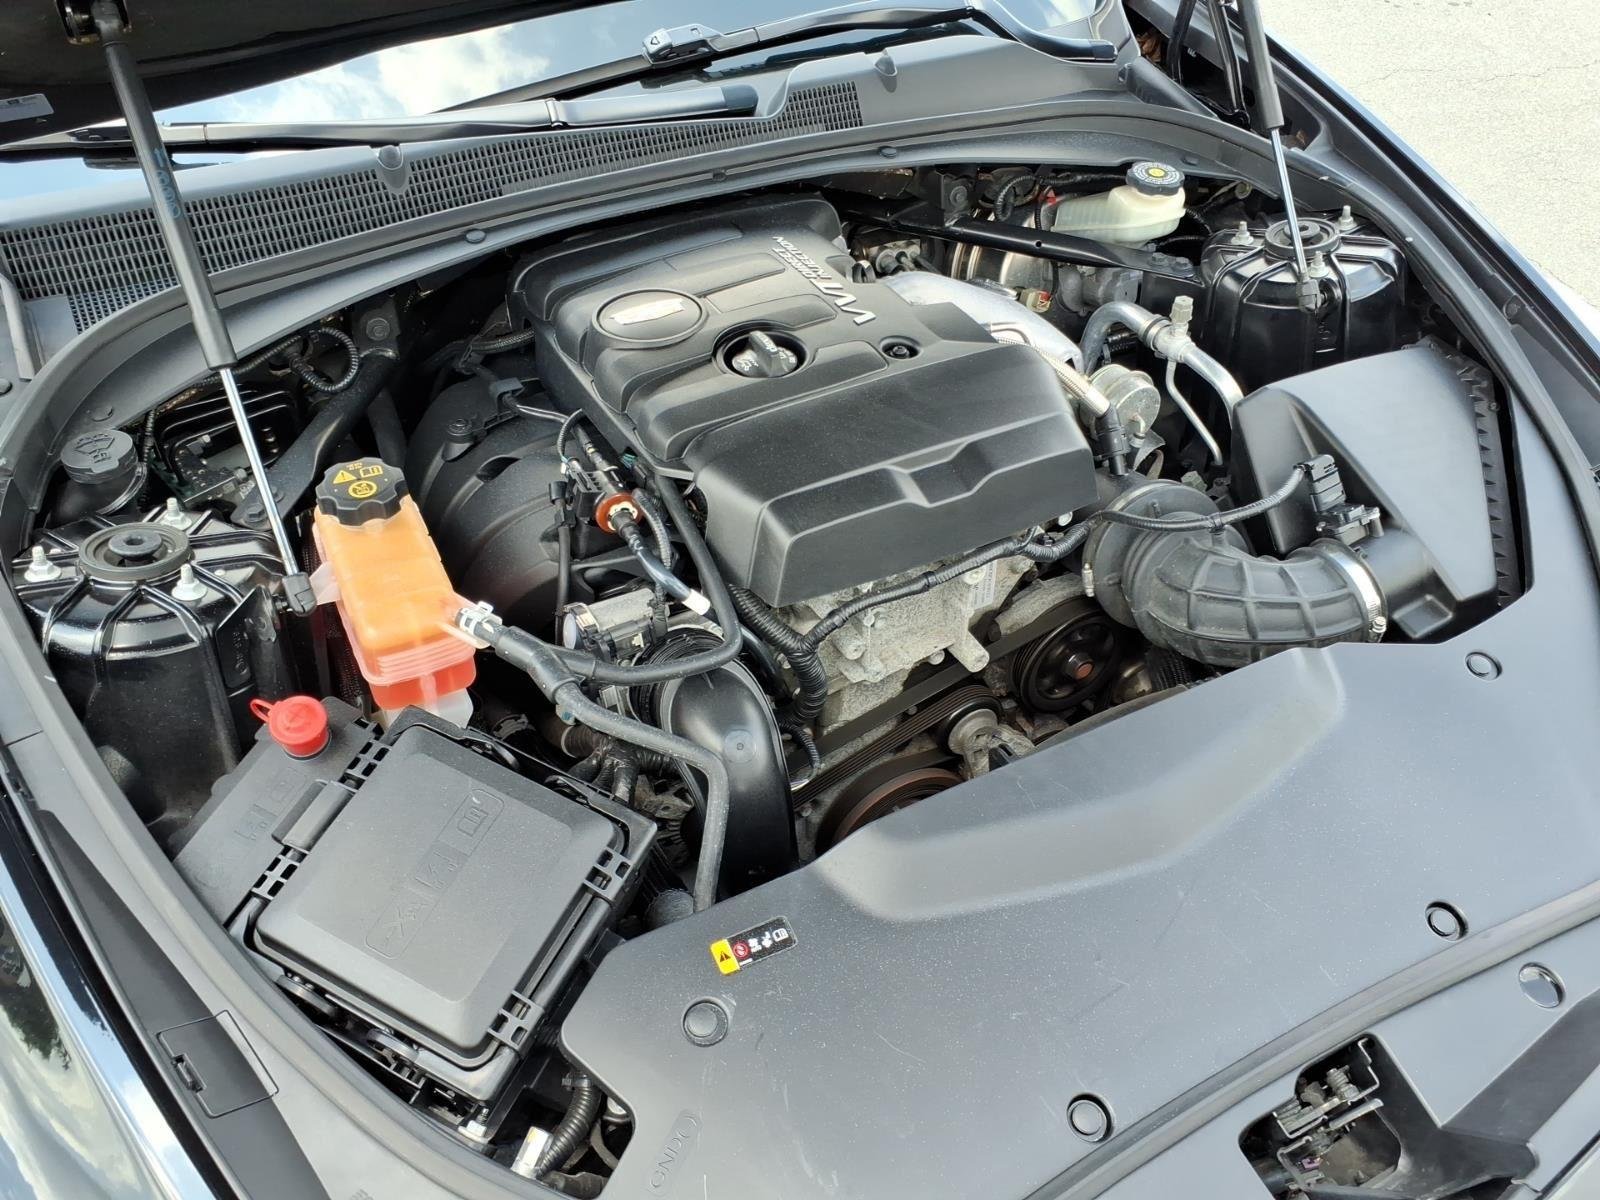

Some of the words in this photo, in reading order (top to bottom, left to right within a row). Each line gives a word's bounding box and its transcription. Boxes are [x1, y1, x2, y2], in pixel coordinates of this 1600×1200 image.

[772, 236, 832, 280] INJECTION
[772, 248, 818, 280] DIRECT
[809, 279, 876, 326] VVT
